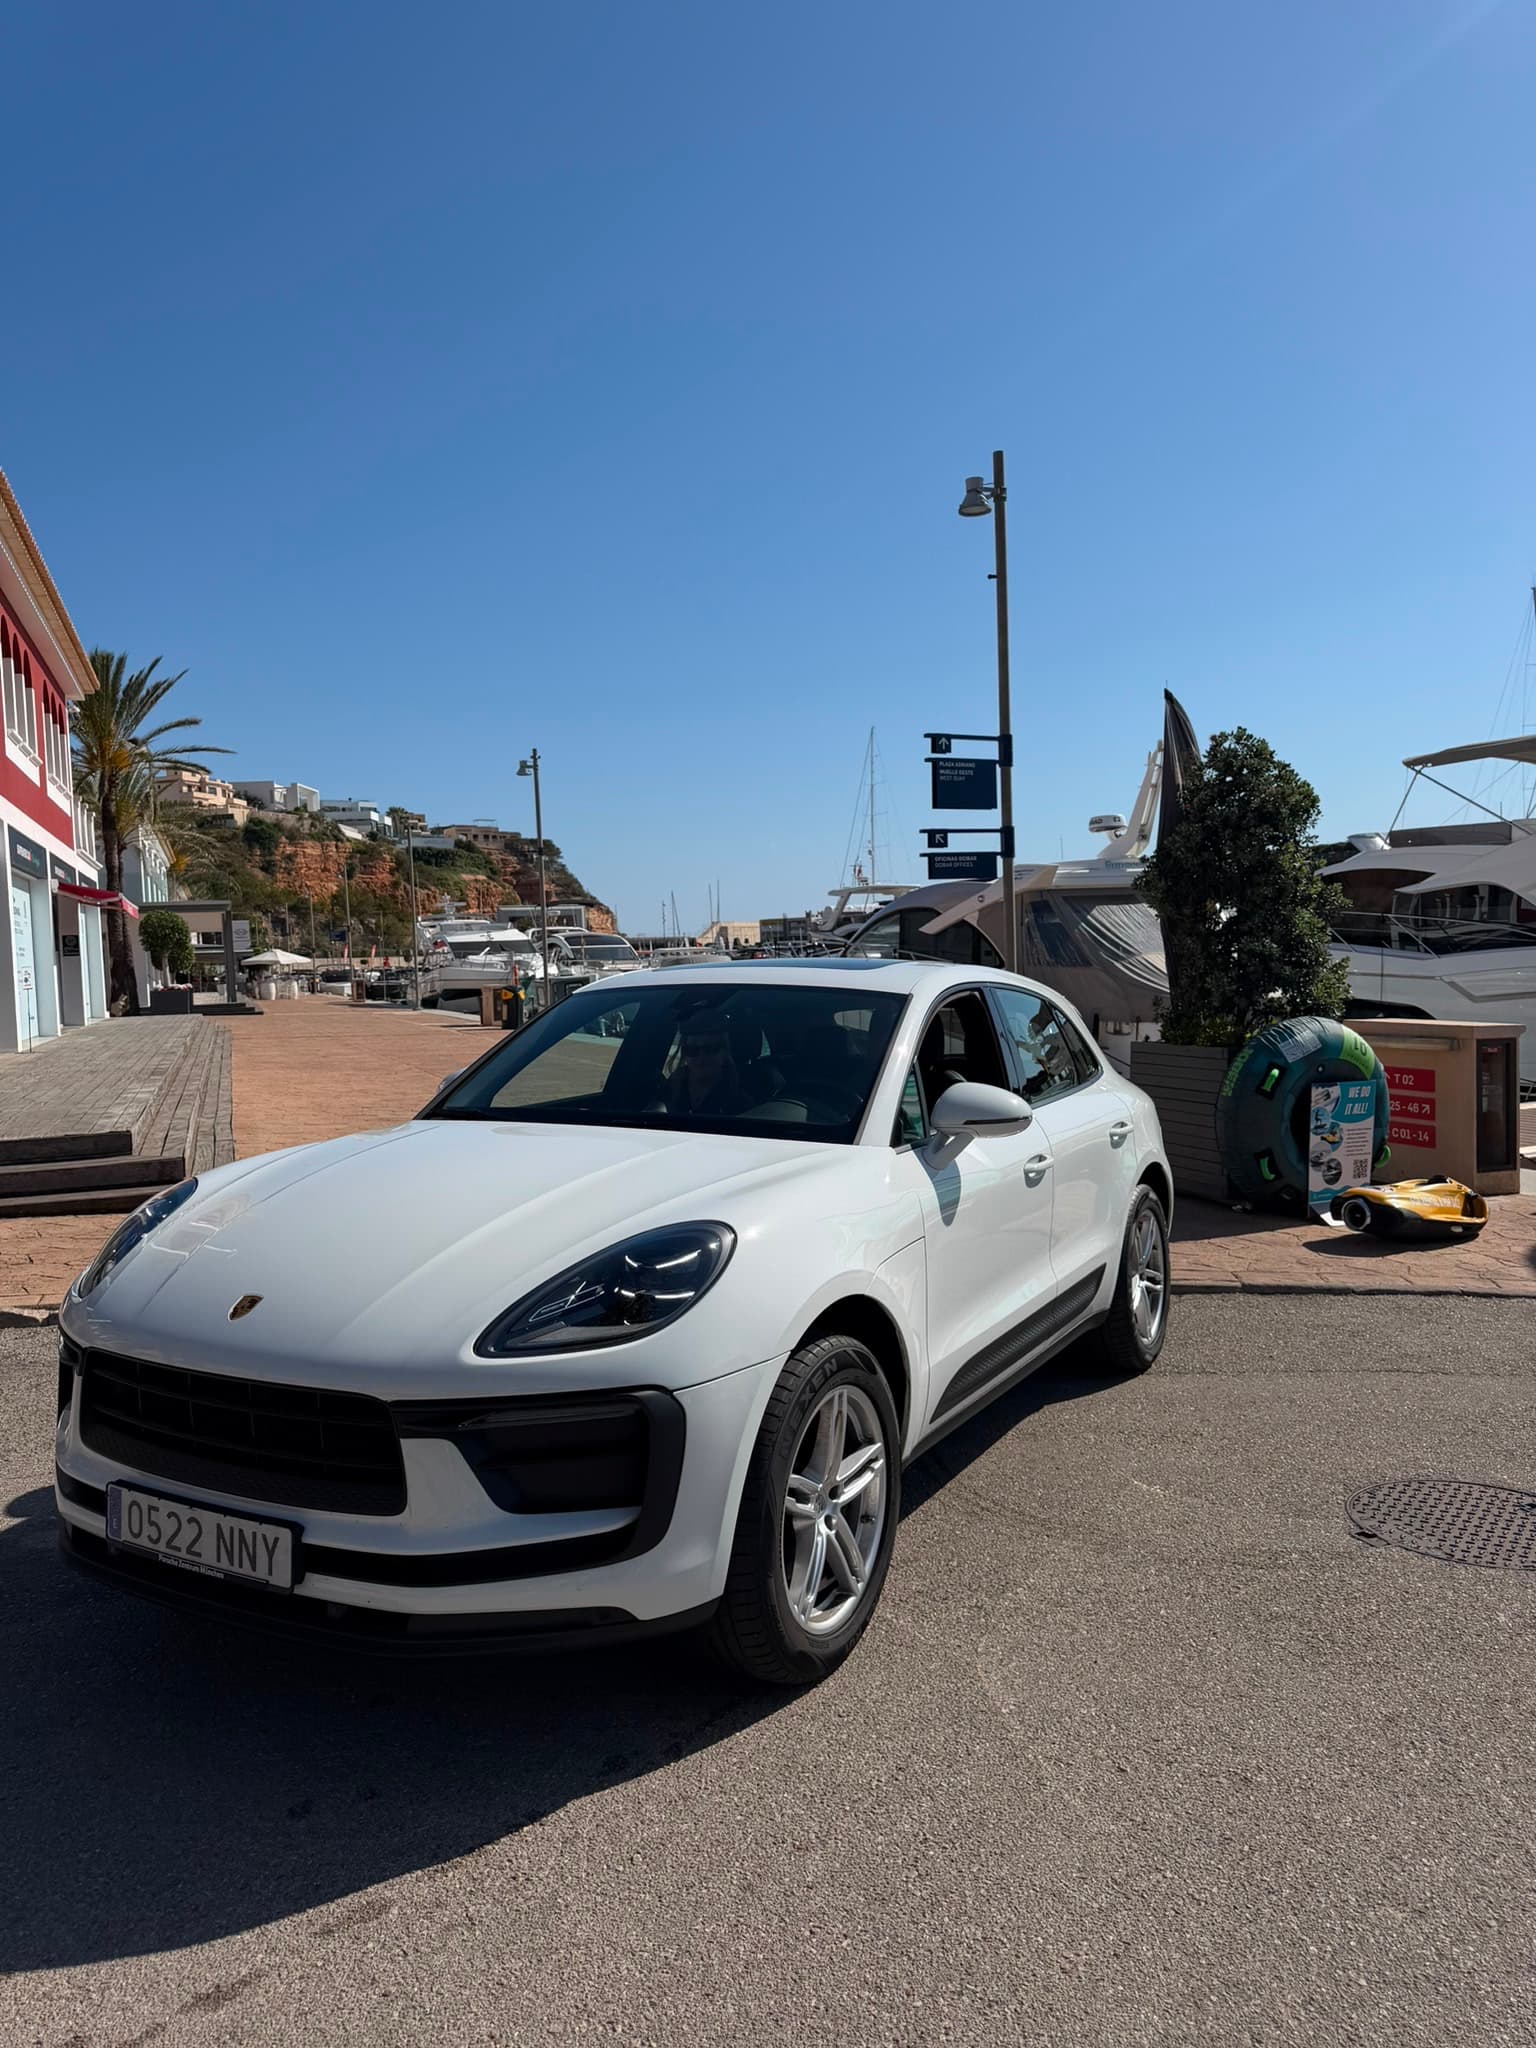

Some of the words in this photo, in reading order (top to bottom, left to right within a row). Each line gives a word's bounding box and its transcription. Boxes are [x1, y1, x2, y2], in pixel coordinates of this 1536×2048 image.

[1348, 1086, 1360, 1098] WE
[1360, 1086, 1372, 1098] DO
[1344, 1103, 1353, 1116] IT
[1352, 1102, 1369, 1114] ALL!
[127, 1500, 203, 1558] 0522
[215, 1522, 280, 1577] NNY
